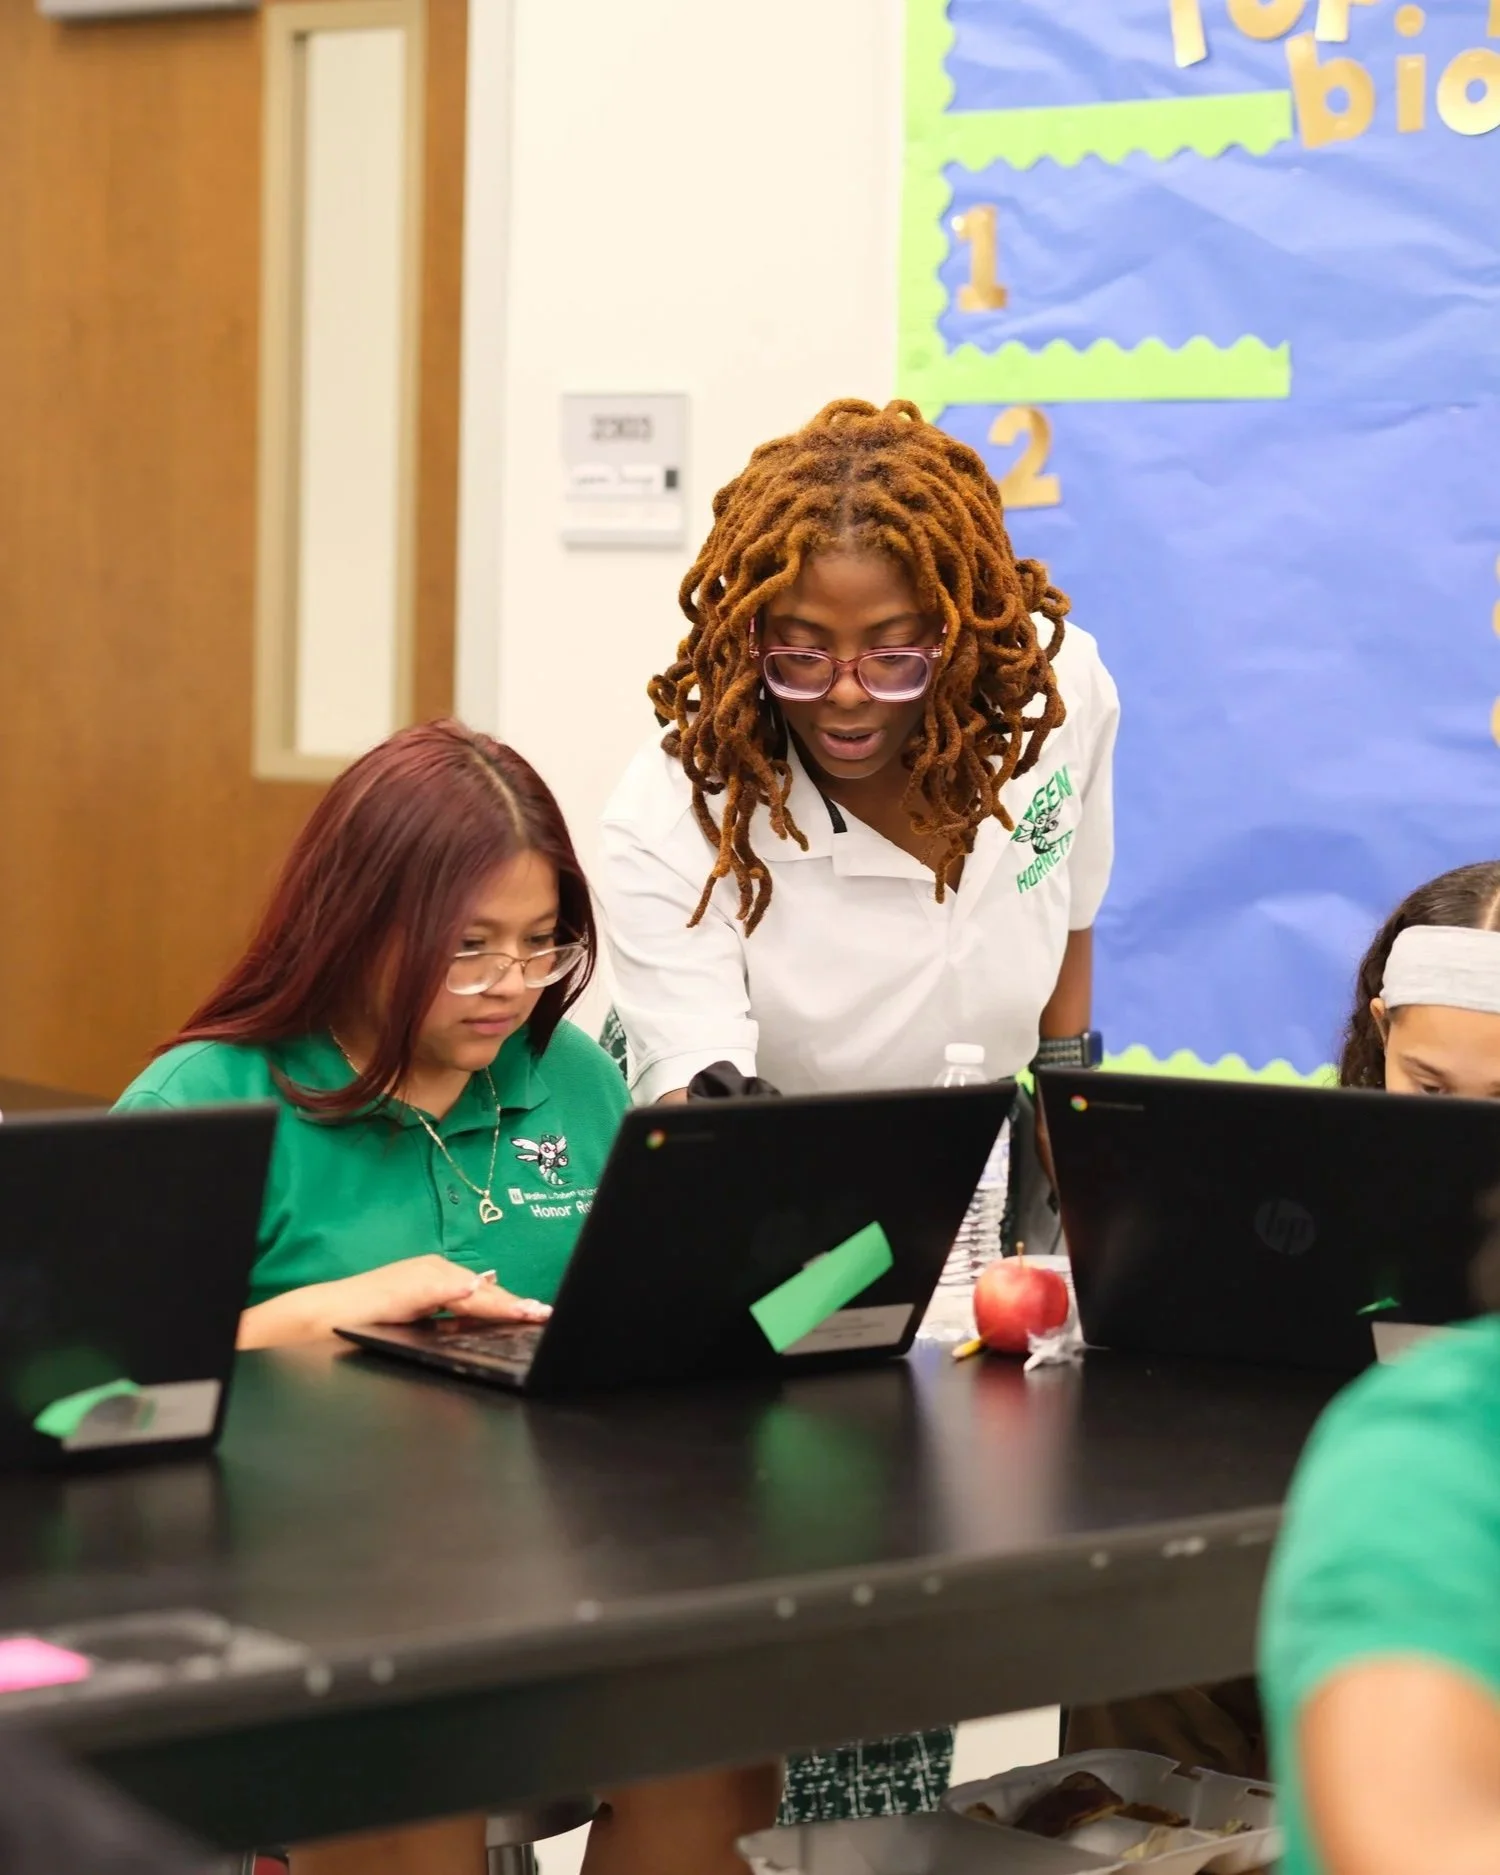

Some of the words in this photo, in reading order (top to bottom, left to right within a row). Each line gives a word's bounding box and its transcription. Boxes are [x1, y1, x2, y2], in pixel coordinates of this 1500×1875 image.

[952, 207, 1006, 311] 1
[988, 405, 1062, 508] 2
[1016, 831, 1073, 893] HORNET
[530, 1204, 572, 1218] Honor
